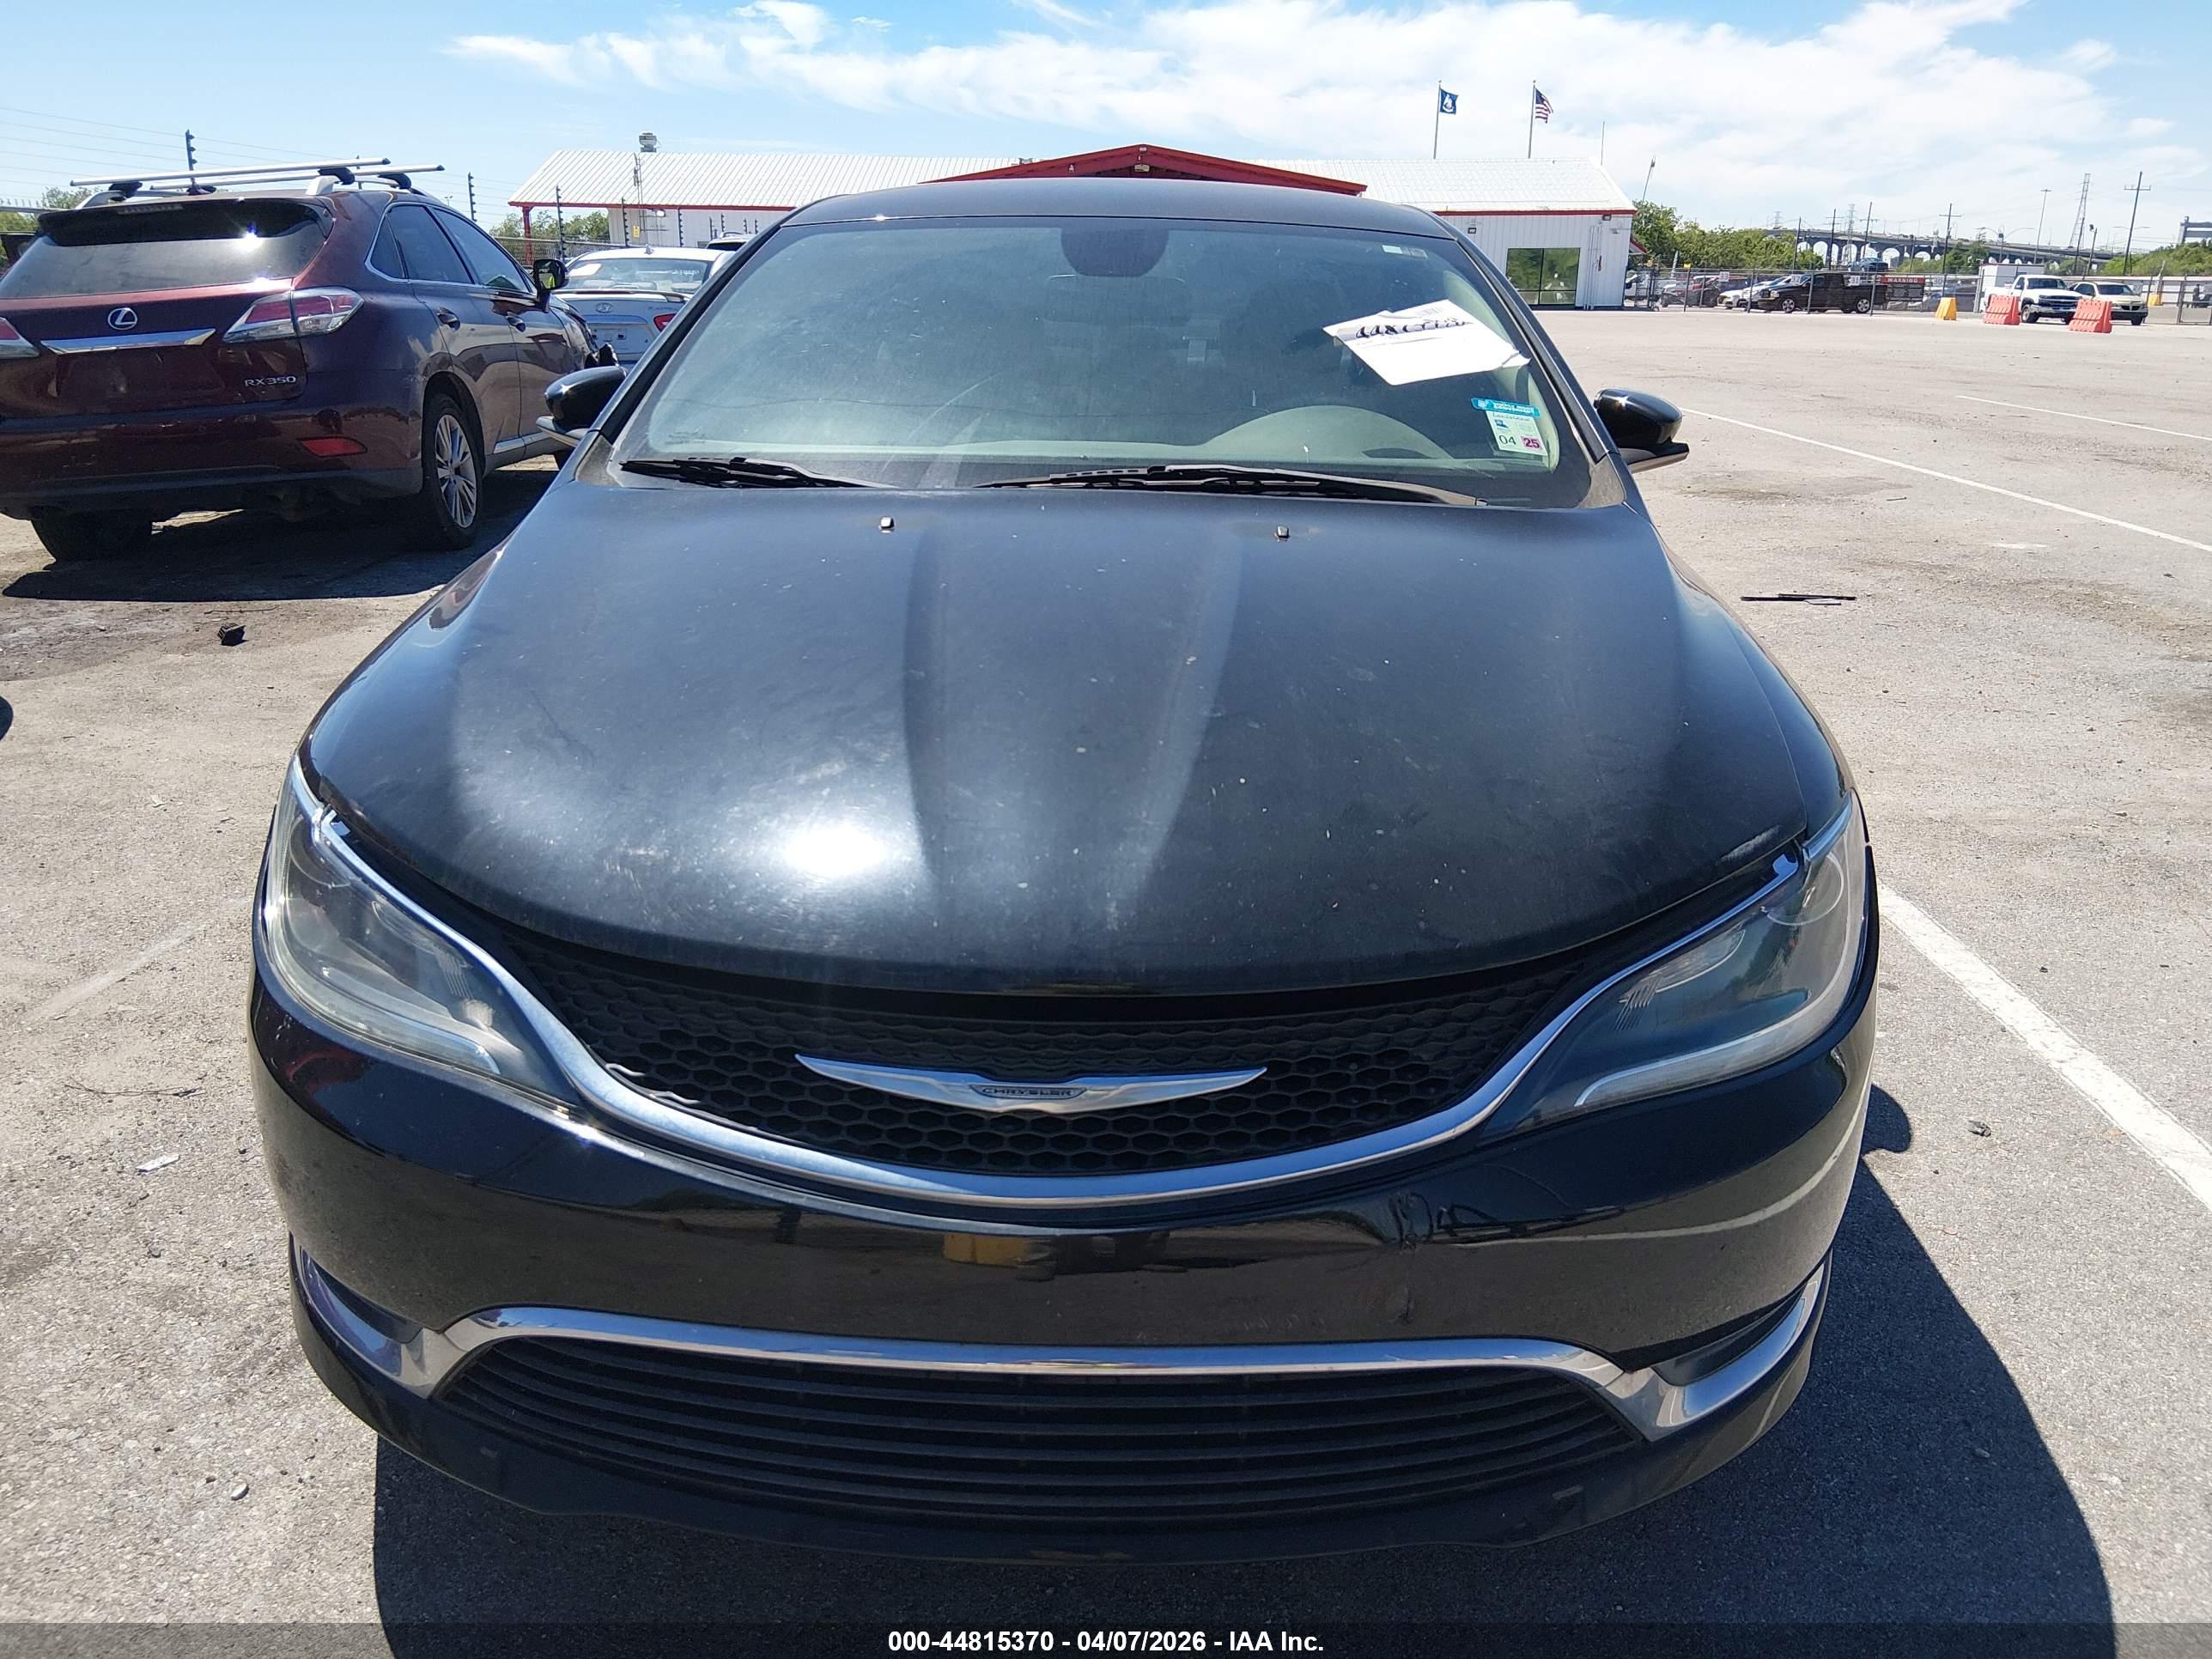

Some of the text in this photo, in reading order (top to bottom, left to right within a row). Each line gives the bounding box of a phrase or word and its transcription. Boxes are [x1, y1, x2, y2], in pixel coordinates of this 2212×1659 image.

[1498, 434, 1540, 448] 04 25
[981, 1087, 1073, 1097] CHRYSLER
